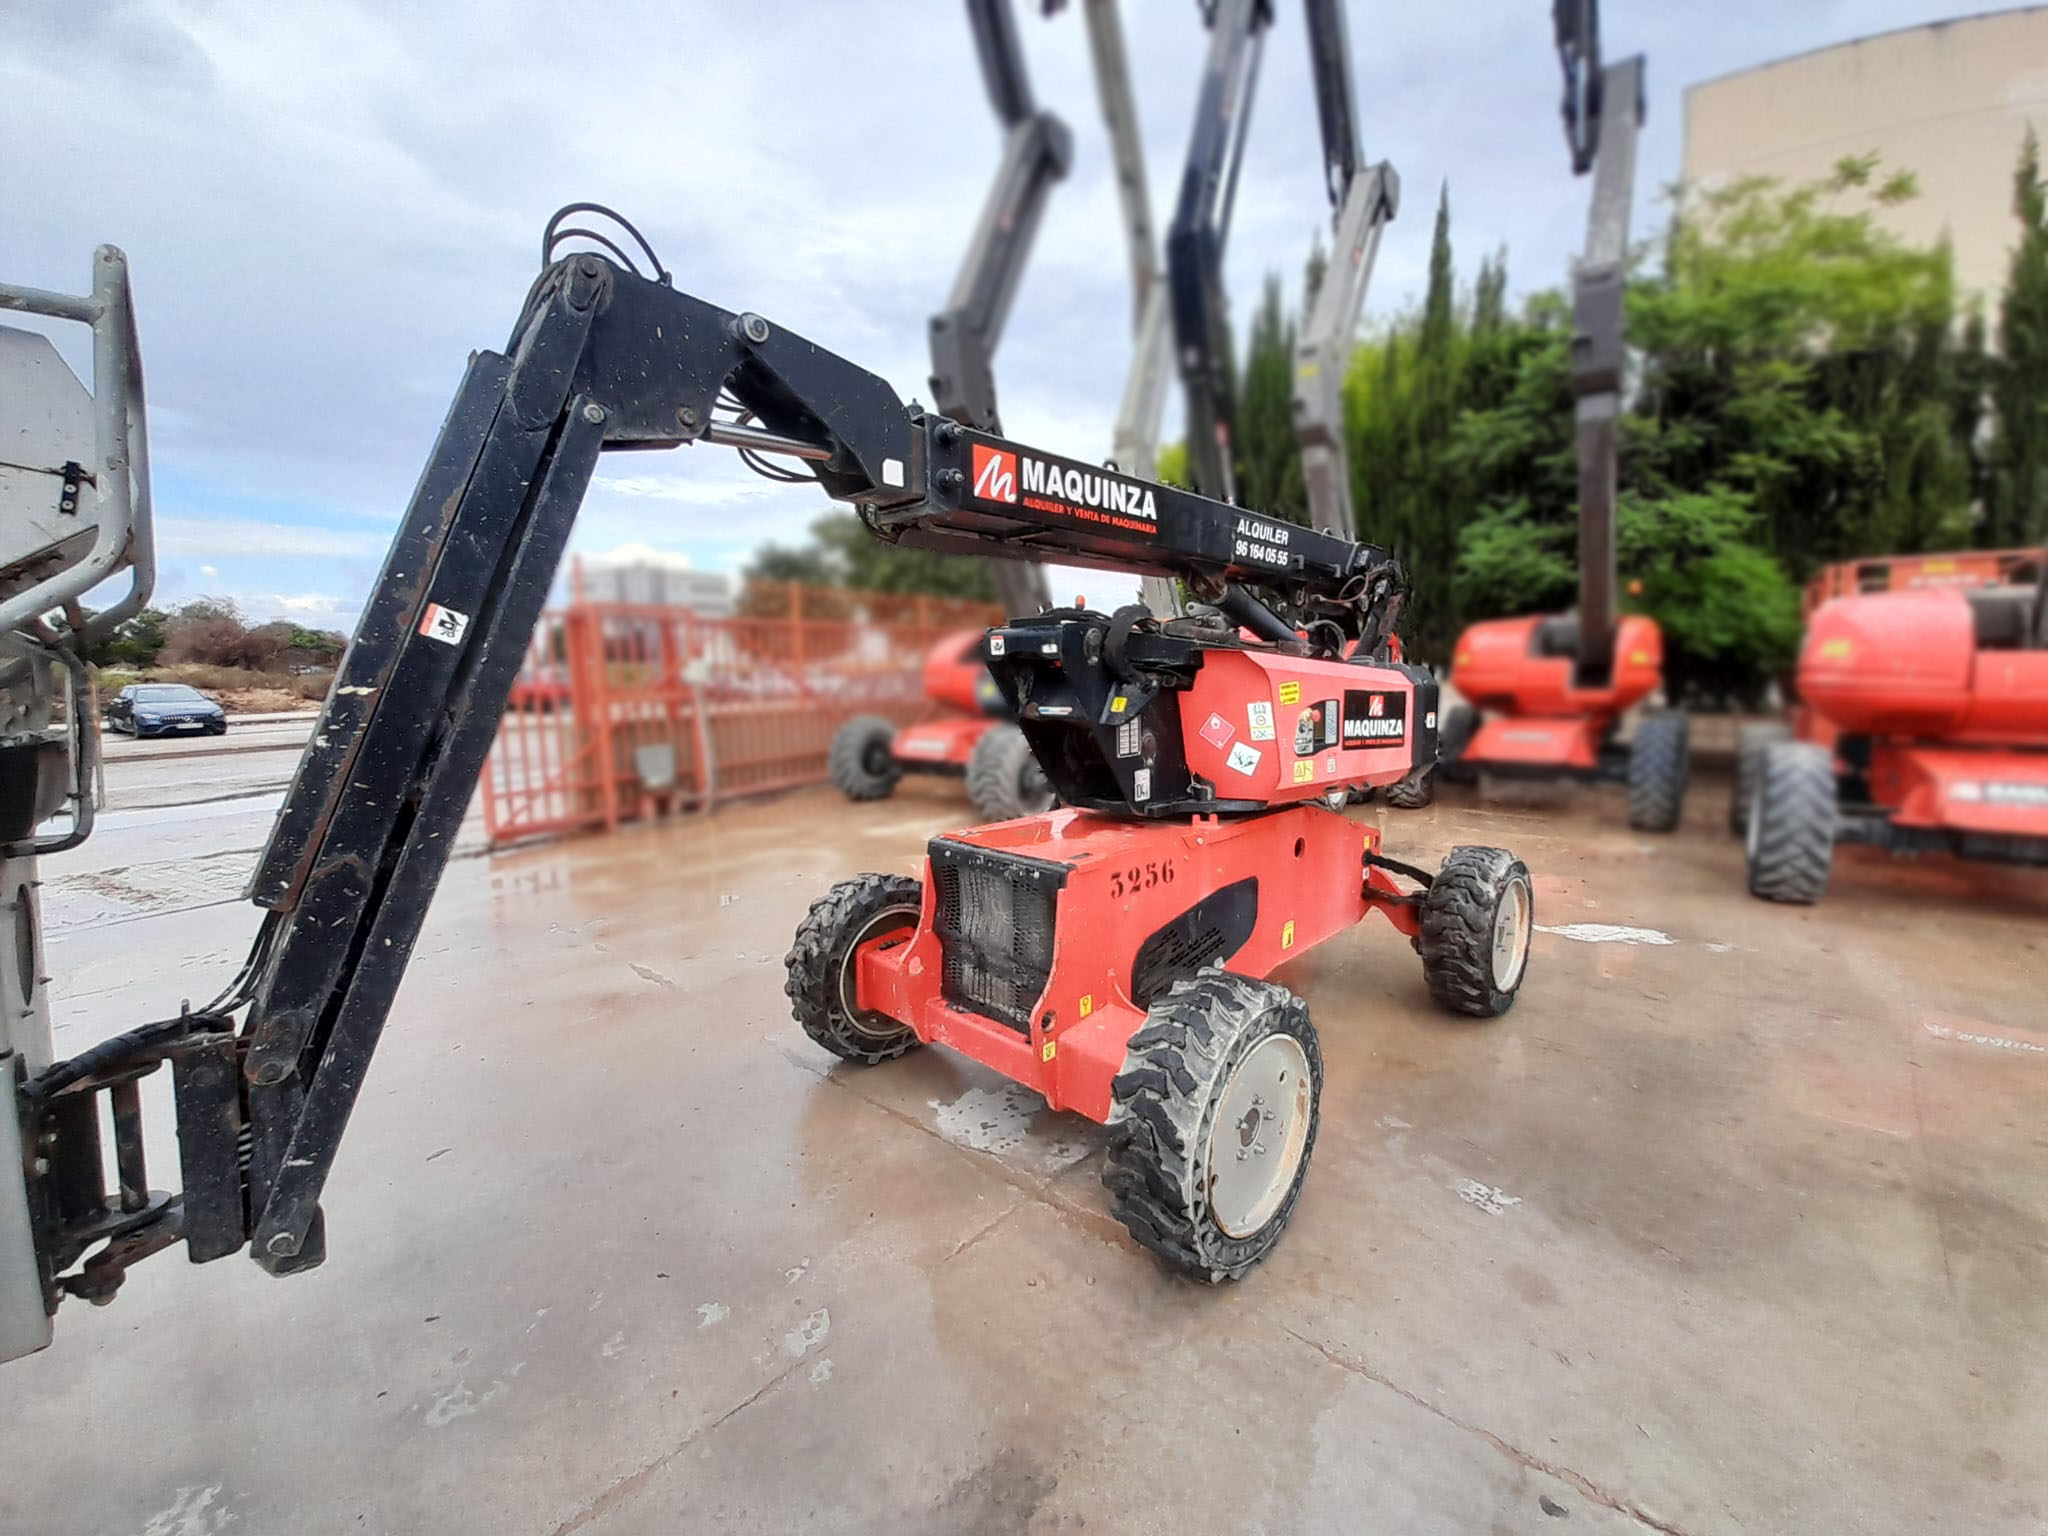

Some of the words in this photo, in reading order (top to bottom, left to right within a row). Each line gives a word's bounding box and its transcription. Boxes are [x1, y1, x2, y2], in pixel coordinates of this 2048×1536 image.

[1022, 457, 1157, 520] MAQUINZA
[1023, 497, 1064, 514] ALQUILER
[1066, 506, 1073, 515] Y
[1074, 507, 1099, 522] VENTA
[1101, 513, 1110, 523] DE
[1112, 516, 1157, 534] MAQUINARIA
[1237, 518, 1289, 546] ALQUILER
[1235, 540, 1248, 556] 96
[1249, 543, 1265, 560] 164
[1265, 547, 1277, 563] 05
[1277, 551, 1289, 566] 55
[1344, 719, 1403, 738] MAQUINZA
[1111, 858, 1174, 899] 3256
